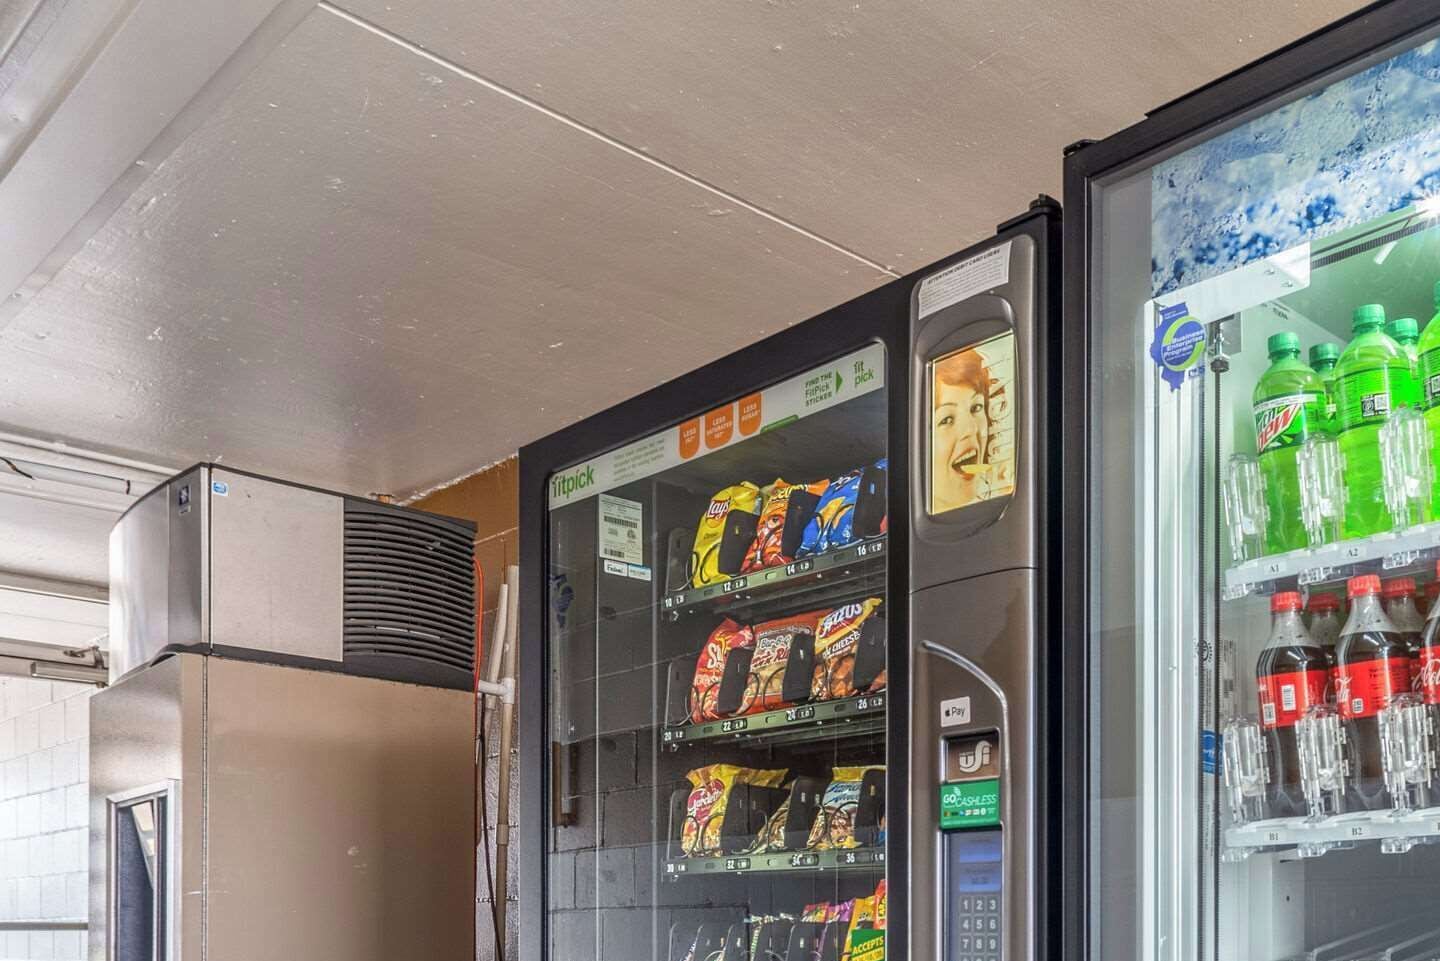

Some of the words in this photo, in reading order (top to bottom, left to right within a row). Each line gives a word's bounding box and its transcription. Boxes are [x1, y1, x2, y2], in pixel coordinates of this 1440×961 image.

[854, 360, 865, 374] fit
[805, 375, 819, 389] FIND
[820, 371, 833, 381] THE
[855, 368, 874, 387] pick
[805, 391, 833, 407] STICKER
[552, 465, 595, 498] fitpick
[857, 545, 867, 556] 16
[1347, 548, 1359, 558] A2
[786, 564, 796, 575] 14
[1269, 563, 1280, 574] A1
[724, 581, 732, 591] 12
[952, 706, 965, 718] Pay
[723, 720, 732, 731] 22
[943, 794, 957, 804] GO
[956, 794, 997, 807] CASHLESS
[1268, 831, 1279, 841] B1
[1351, 826, 1363, 836] B2
[852, 936, 884, 955] ACCEPTS
